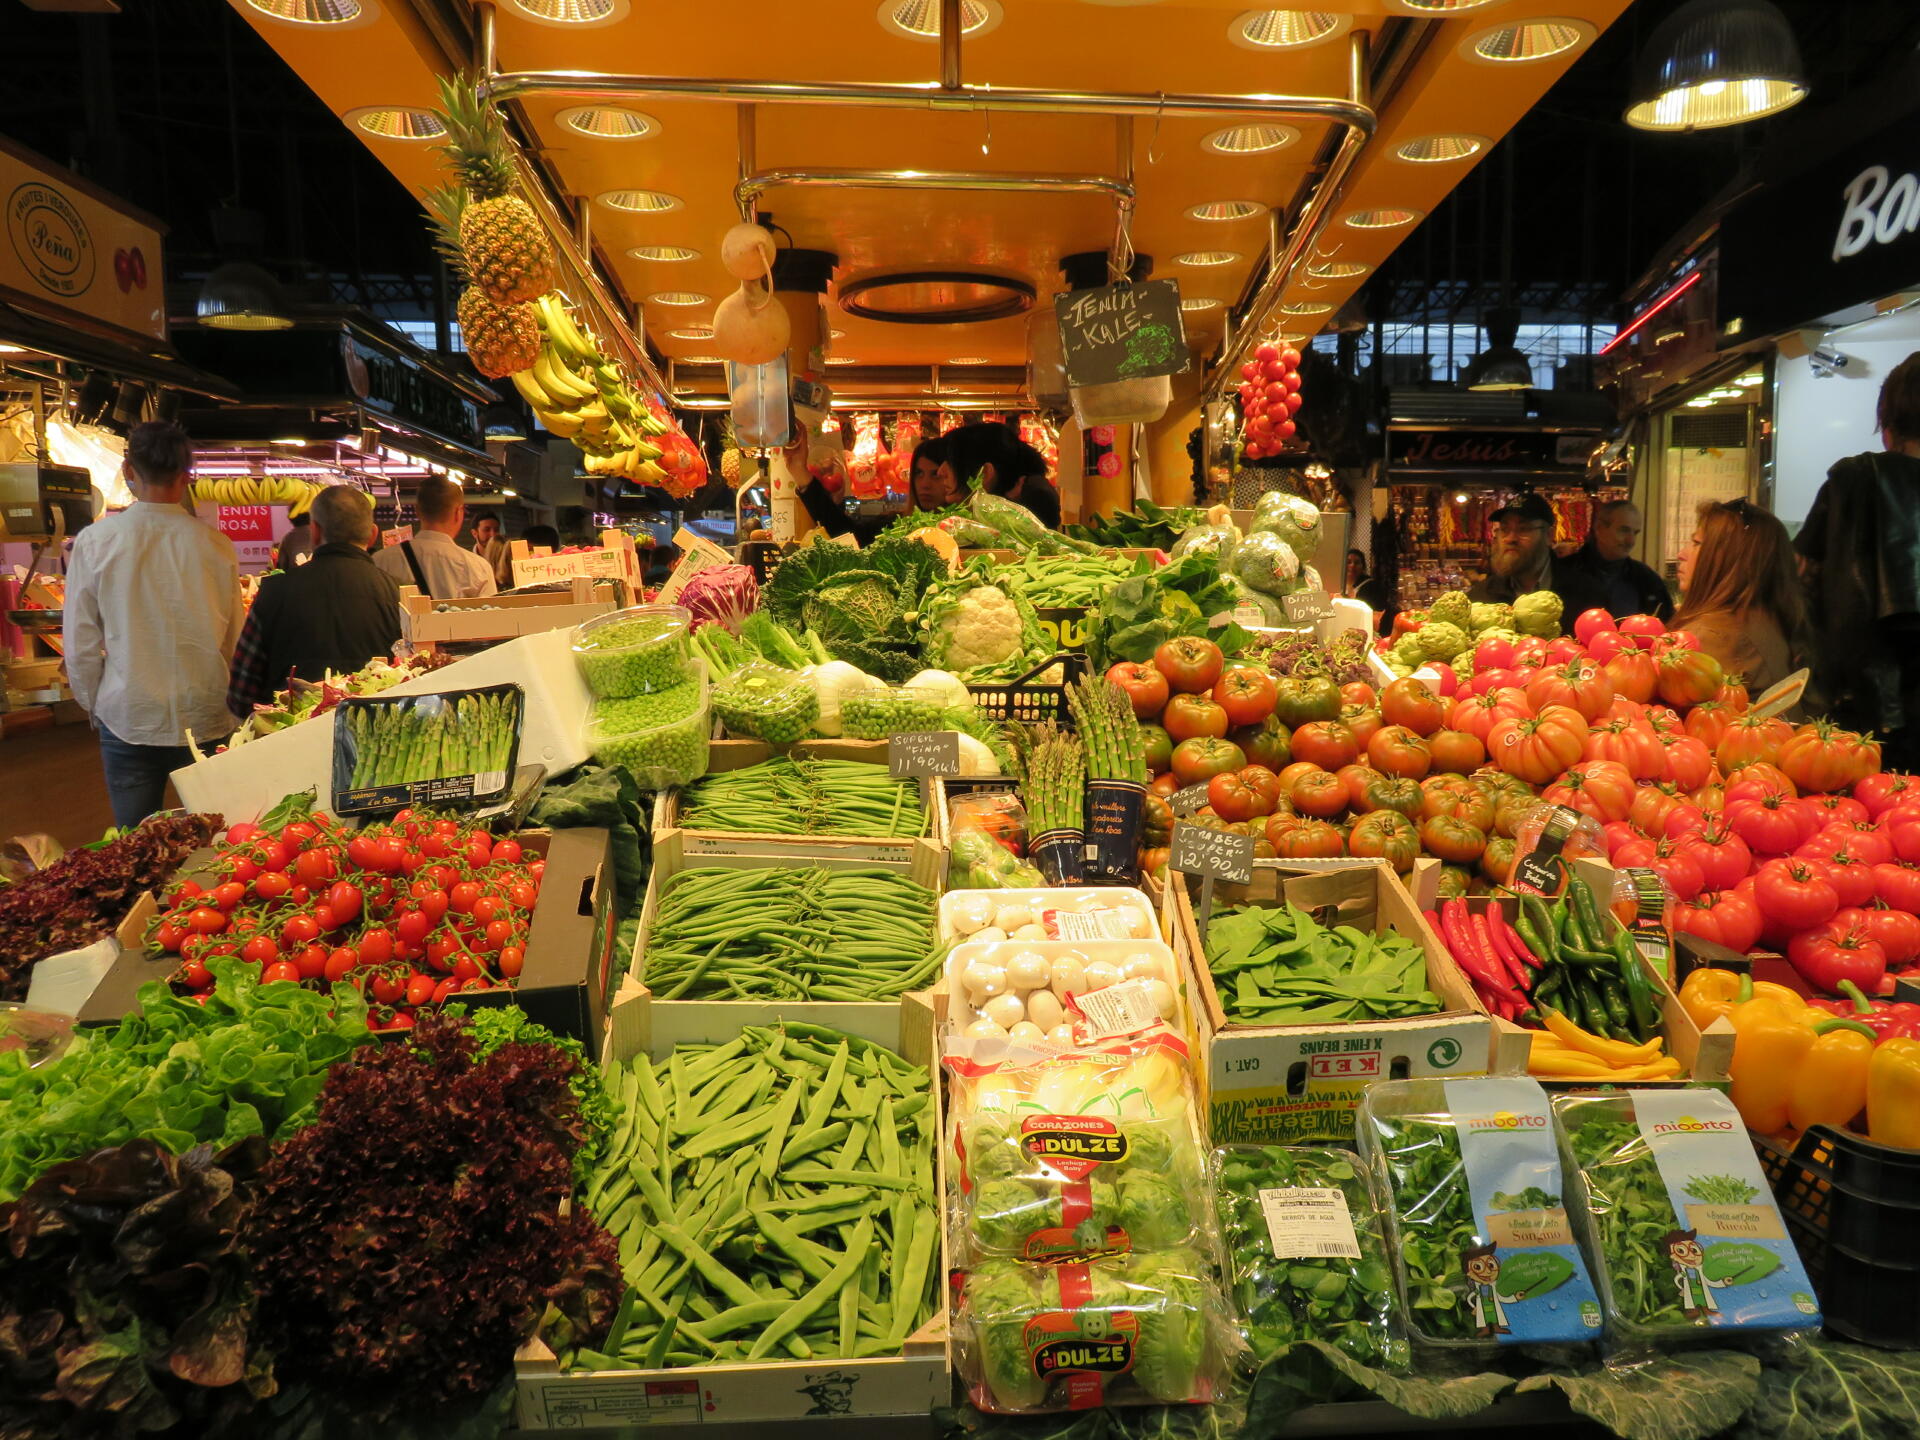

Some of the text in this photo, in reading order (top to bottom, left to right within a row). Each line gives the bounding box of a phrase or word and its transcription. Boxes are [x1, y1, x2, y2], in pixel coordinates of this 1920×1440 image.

[219, 519, 260, 531] ROSA
[1300, 1037, 1383, 1054] X FINE BEANS
[1236, 1057, 1260, 1072] CAT.
[1029, 1122, 1105, 1130] CORAZONES
[1237, 1115, 1317, 1132] Beans
[1715, 1220, 1758, 1232] Rucola
